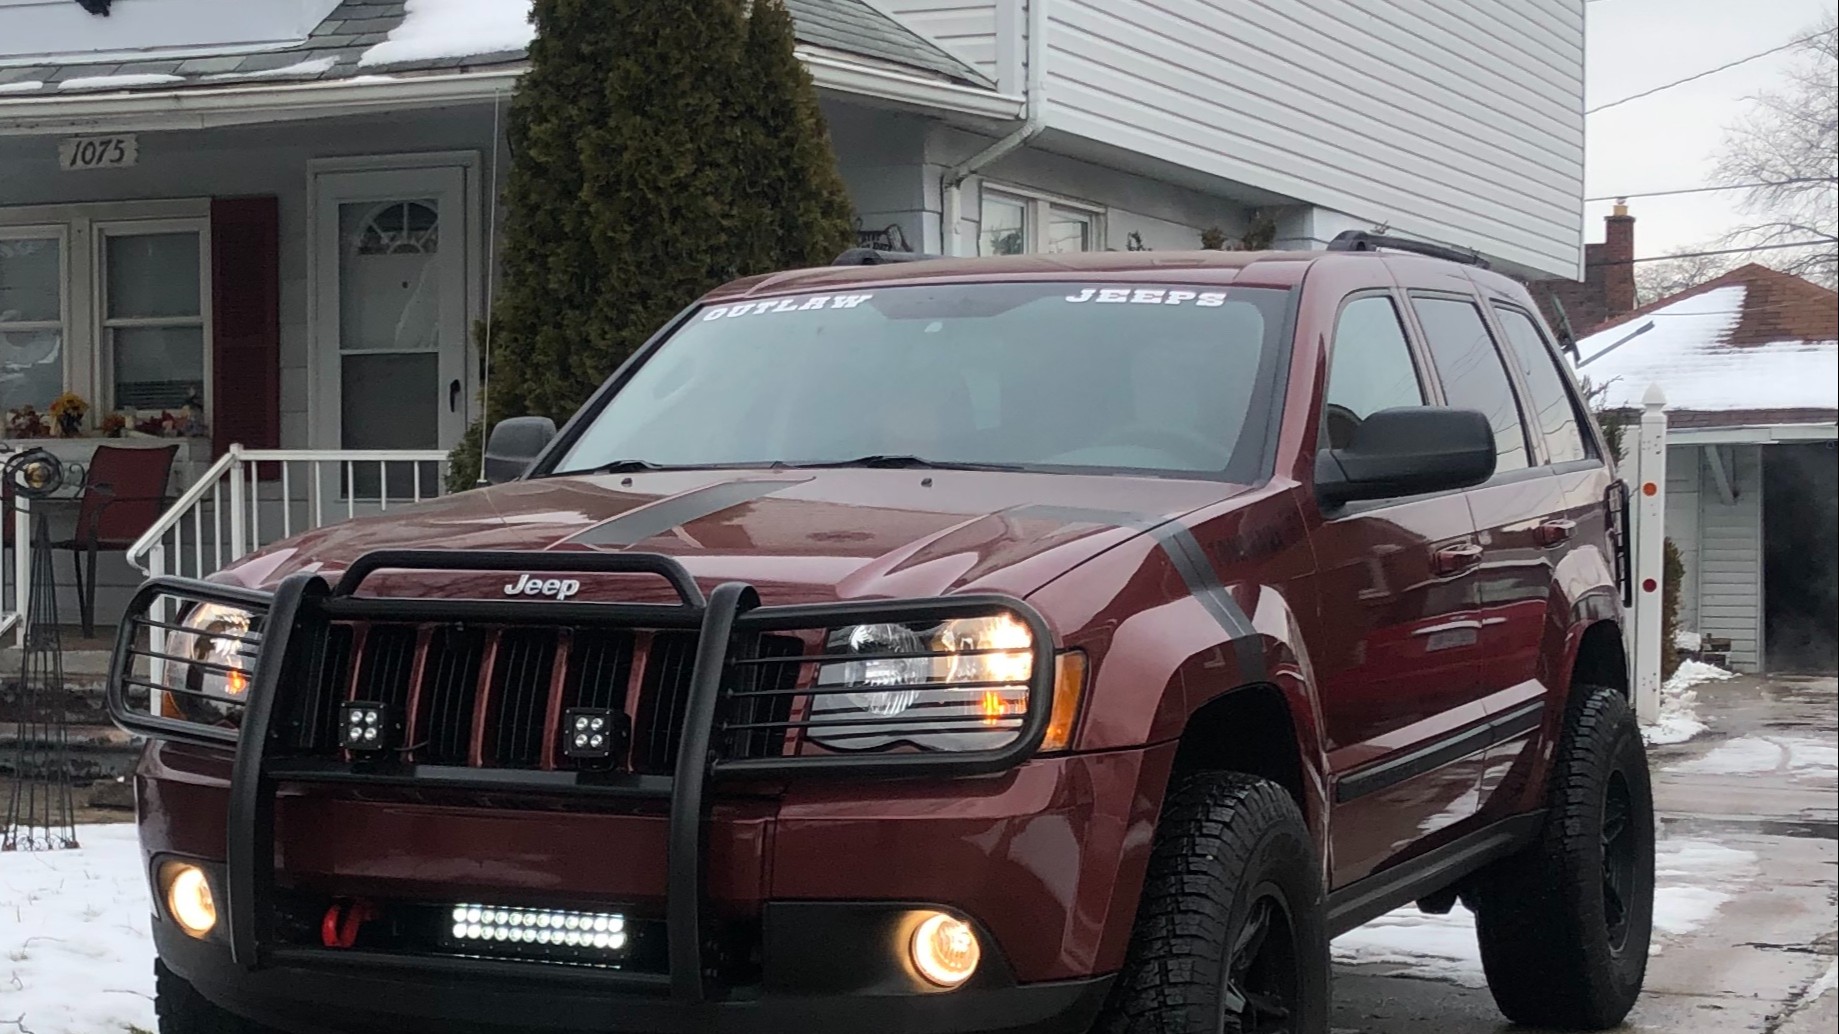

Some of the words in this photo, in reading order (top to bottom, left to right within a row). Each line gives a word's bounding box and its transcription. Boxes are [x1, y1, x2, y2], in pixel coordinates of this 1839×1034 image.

[69, 139, 125, 167] 1075
[703, 294, 874, 322] OUTLAW
[1065, 288, 1228, 308] JEEPS
[503, 574, 580, 600] Jeep
